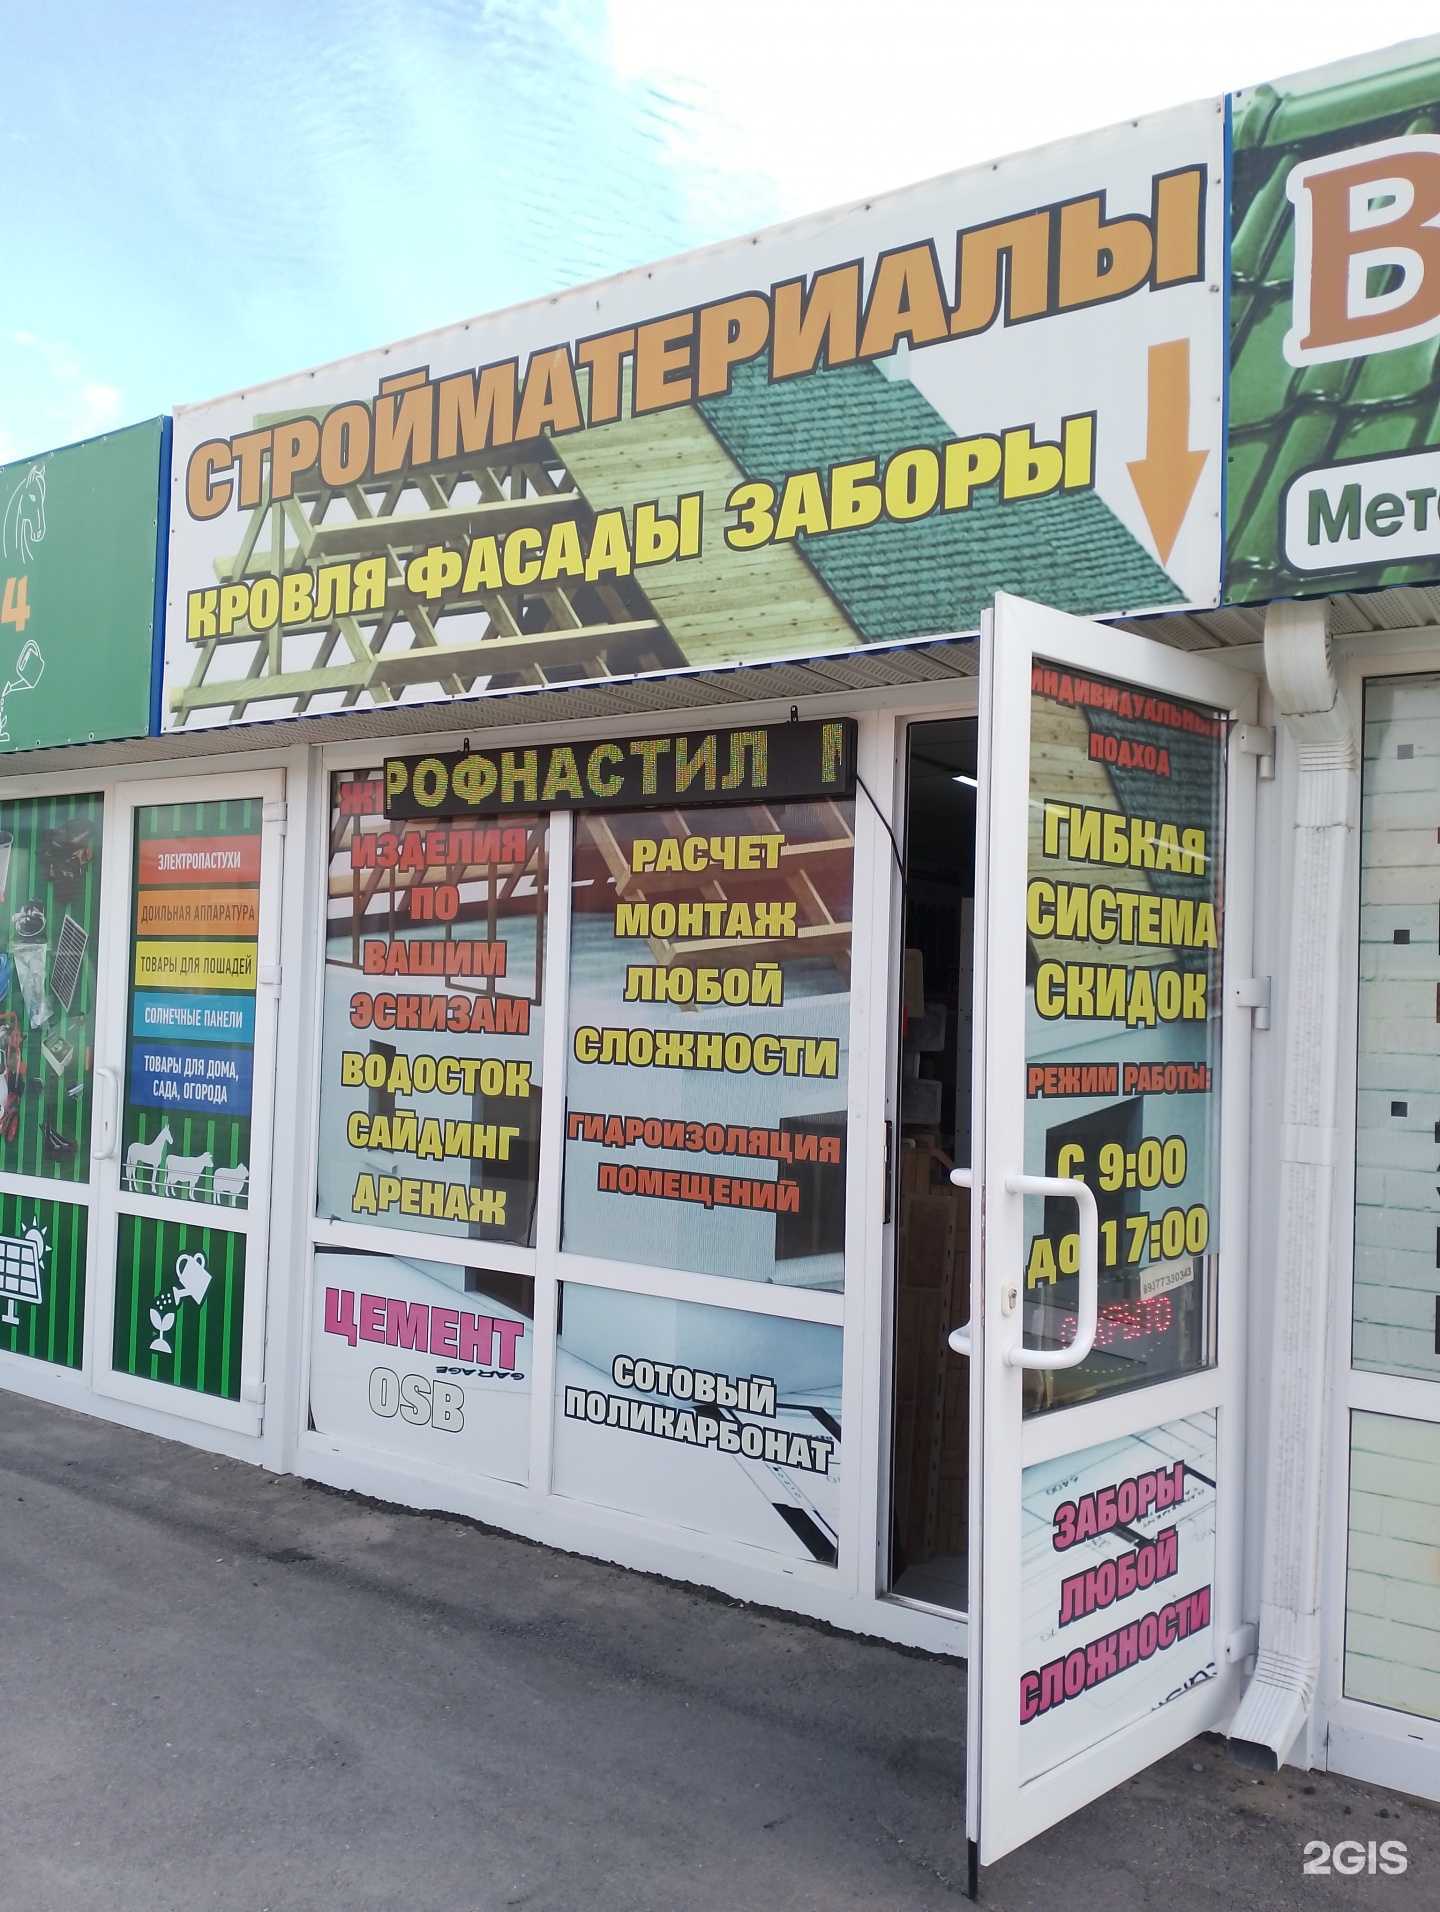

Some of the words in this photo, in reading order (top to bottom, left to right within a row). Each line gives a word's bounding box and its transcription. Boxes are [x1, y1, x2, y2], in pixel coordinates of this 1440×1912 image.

[186, 163, 1208, 521] СТРОЙМАТЕРИАЛЫ
[724, 411, 1098, 551] ЗАБОРЫ
[1307, 483, 1440, 546] Мет
[186, 553, 388, 642] КРОВЛЯ
[405, 490, 704, 600] ФАСАДЫ
[386, 730, 768, 808] РОФНАСТИЛ
[1088, 731, 1171, 778] ПОДХОД
[157, 851, 241, 871] ЭЛЕКТРОПАСТУХИ
[350, 827, 528, 873] ИЗДЕЛИЯ
[630, 832, 786, 875] РАСЧЕТ
[1043, 798, 1207, 878] ГИБКАЯ
[140, 905, 191, 923] ДОИЛЬНАЯ
[193, 903, 255, 921] АППАРАТУРА
[409, 885, 461, 921] ПО
[613, 900, 798, 940] МОНТАЖ
[1026, 876, 1218, 949] СИСТЕМА
[140, 956, 177, 974] ТОВАРЫ
[180, 957, 200, 976] ДЛЯ
[203, 953, 252, 977] ЛОШАДЕЙ
[362, 940, 508, 978] ВАШИМ
[622, 961, 785, 1008] ЛЮБОЙ
[144, 1007, 201, 1027] СОЛНЕЧНЫЕ
[204, 1010, 243, 1029] ПАНЕЛИ
[350, 991, 531, 1036] ЭСКИЗАМ
[1034, 958, 1209, 1030] СКИДОК
[144, 1055, 181, 1074] ТОВАРЫ
[184, 1058, 204, 1078] ДЛЯ
[207, 1060, 239, 1082] ДОМА,
[340, 1050, 533, 1098] ВОДОСТОК
[573, 1025, 840, 1080] СЛОЖНОСТИ
[153, 1080, 181, 1101] САДА,
[183, 1082, 228, 1105] ОГОРОДА
[1026, 1062, 1119, 1099] РЕЖИМ
[346, 1110, 521, 1162] САЙДИНГ
[567, 1111, 841, 1164] ГИДРОИЗОЛЯЦИЯ
[597, 1162, 801, 1214] ПОМЕЩЕНИЙ
[1057, 1142, 1085, 1181] С
[1098, 1135, 1187, 1193] 9:00
[351, 1172, 507, 1226] ДРЕНАЖ
[1027, 1233, 1080, 1290] ДО
[1100, 1205, 1210, 1267] 17:00
[324, 1287, 525, 1371] ЦЕМЕНТ
[1060, 1295, 1171, 1350] ОКРЫТО
[369, 1366, 465, 1433] OSB
[612, 1354, 777, 1418] СОТОВЫЙ
[565, 1385, 834, 1475] ПОЛИКАРБОНАТ
[1053, 1459, 1185, 1551] ЗАБОРЫ
[1059, 1524, 1179, 1628] ЛЮБОЙ
[1020, 1584, 1211, 1725] СЛОЖНОСТИ
